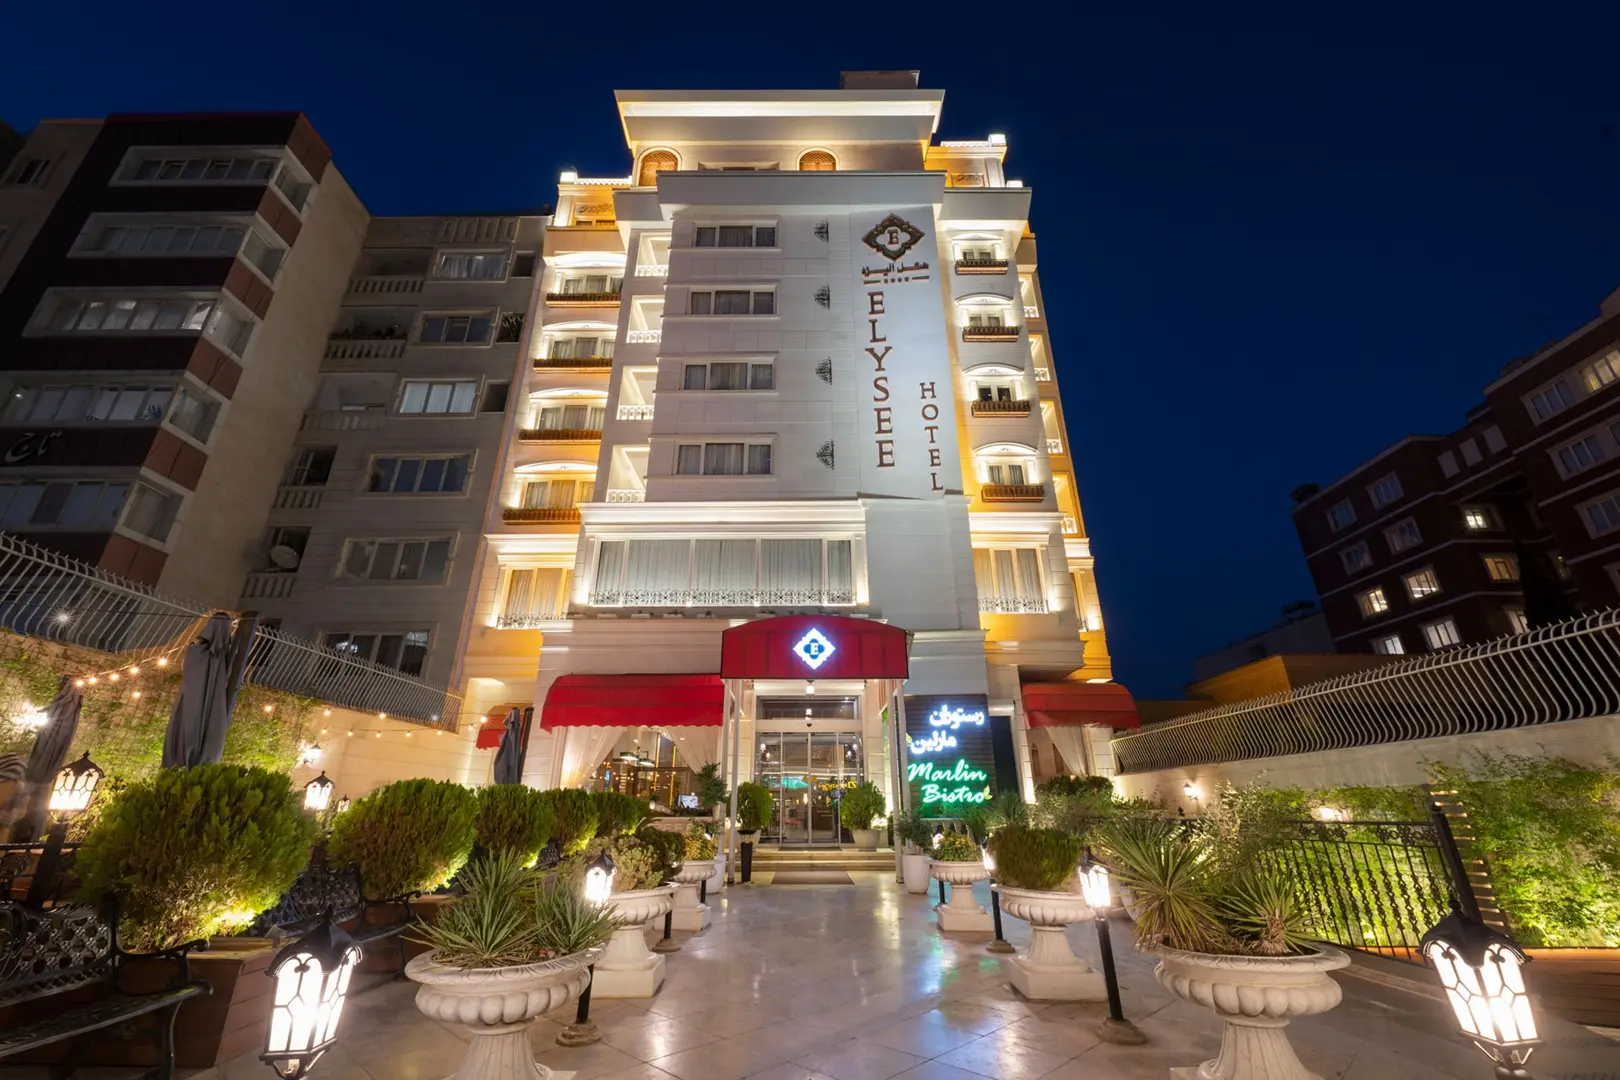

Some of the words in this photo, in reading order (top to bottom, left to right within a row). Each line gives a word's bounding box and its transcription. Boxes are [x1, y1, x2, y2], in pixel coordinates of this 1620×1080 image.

[887, 229, 899, 245] E
[897, 261, 929, 273] هتل
[865, 291, 895, 467] ELYSEE
[919, 381, 943, 491] HOTEL
[810, 642, 819, 655] E
[929, 704, 985, 729] رستوران
[907, 759, 987, 782] Marlin
[921, 783, 985, 803] Bistro
